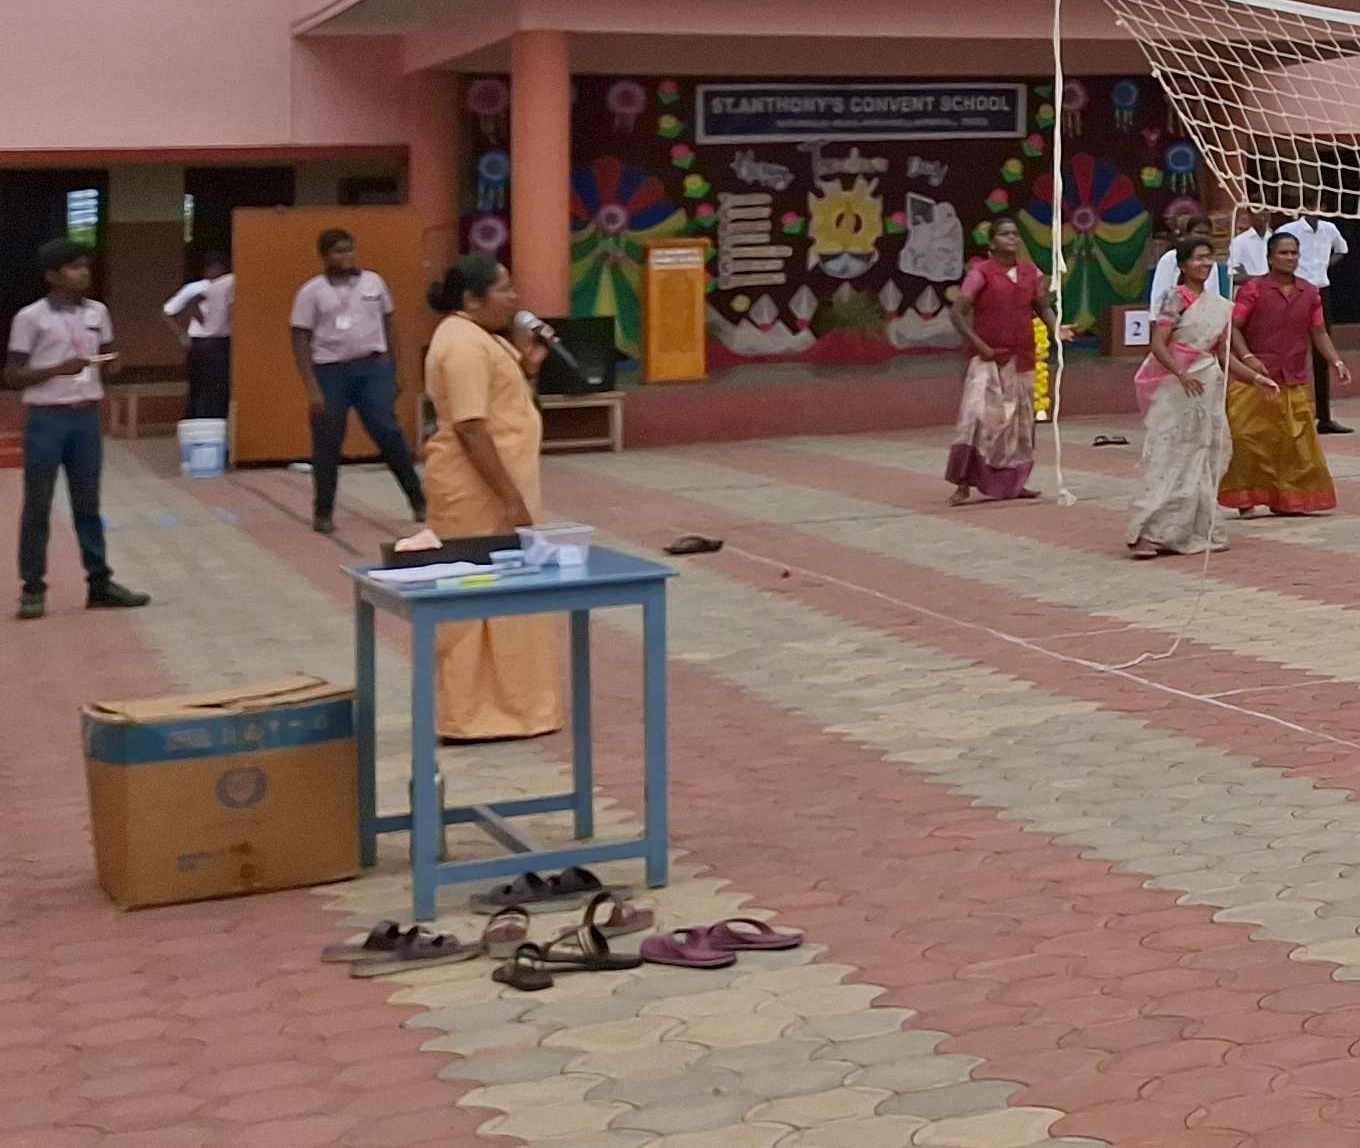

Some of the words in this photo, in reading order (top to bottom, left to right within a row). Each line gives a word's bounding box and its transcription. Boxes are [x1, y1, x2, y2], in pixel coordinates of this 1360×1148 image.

[849, 95, 935, 112] CONVENT
[939, 94, 1011, 111] SCHOOL
[1132, 320, 1142, 337] 2
